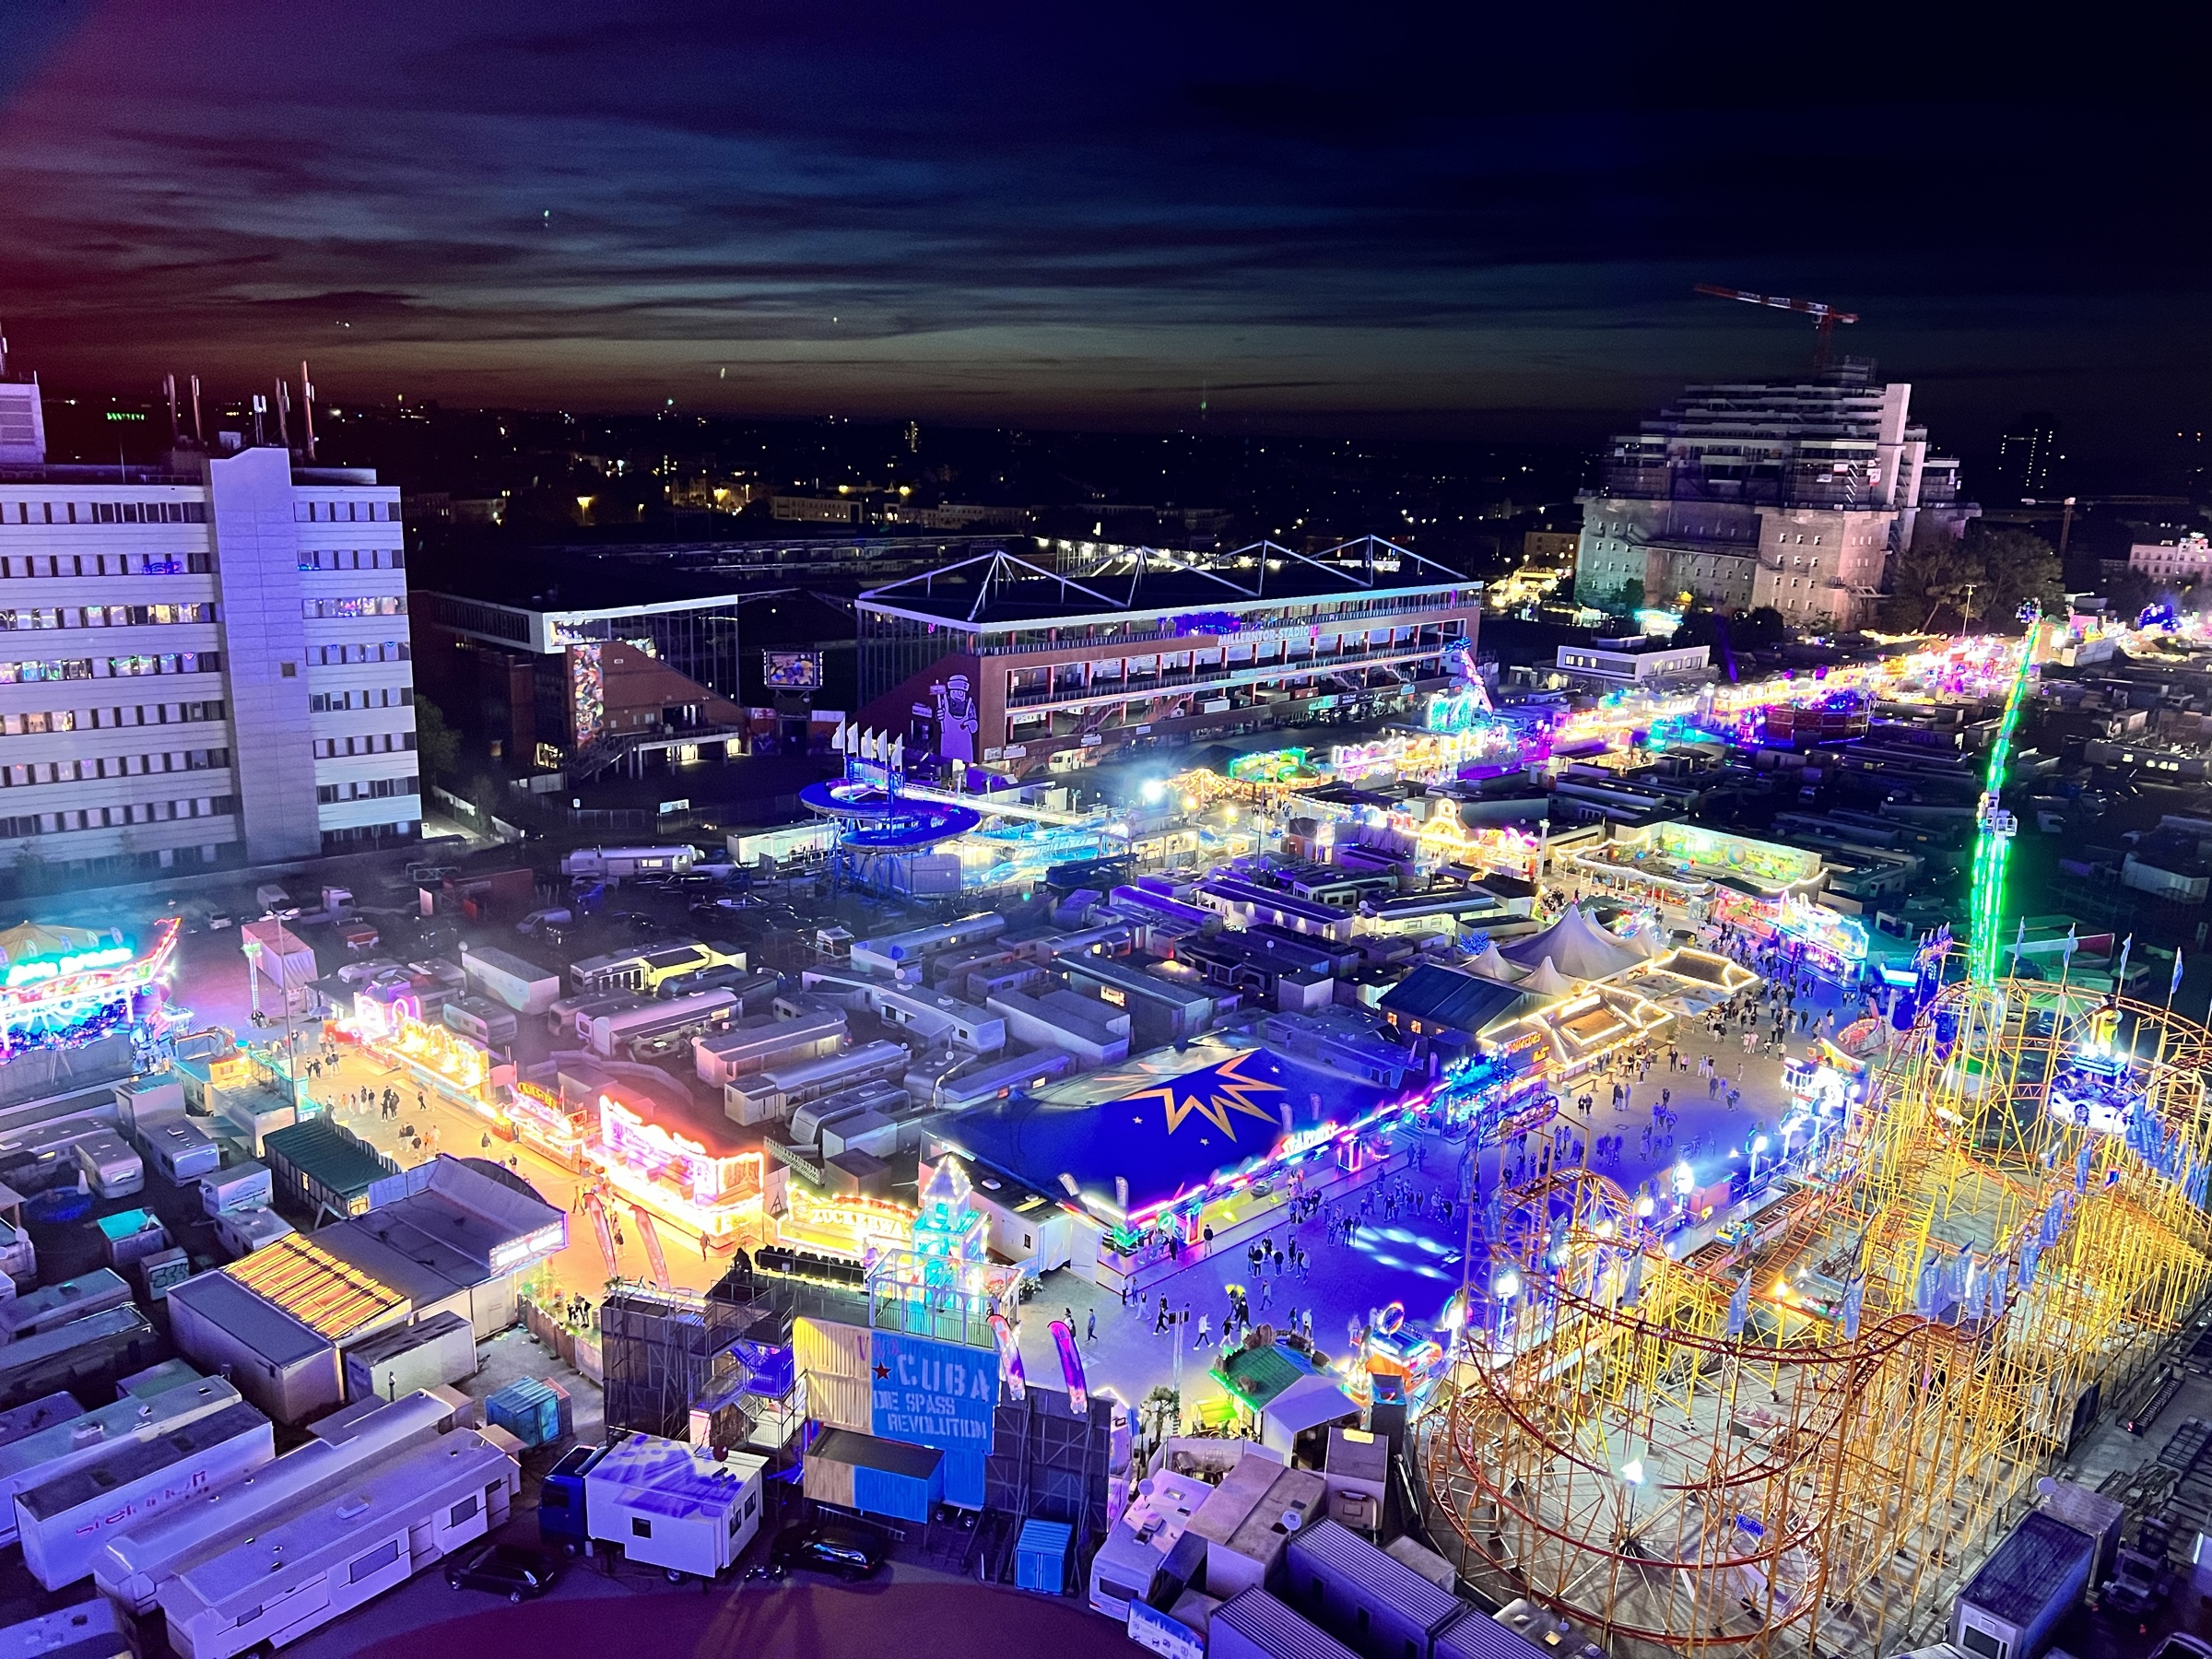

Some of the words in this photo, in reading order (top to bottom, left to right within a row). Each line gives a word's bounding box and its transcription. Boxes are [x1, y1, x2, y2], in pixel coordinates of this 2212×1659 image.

[1218, 625, 1319, 646] MILLERNTOR-STADION
[896, 1354, 991, 1403] CUBA
[873, 1390, 900, 1411] DIE
[905, 1393, 956, 1416] SPASS
[888, 1414, 987, 1440] REVOLUTION
